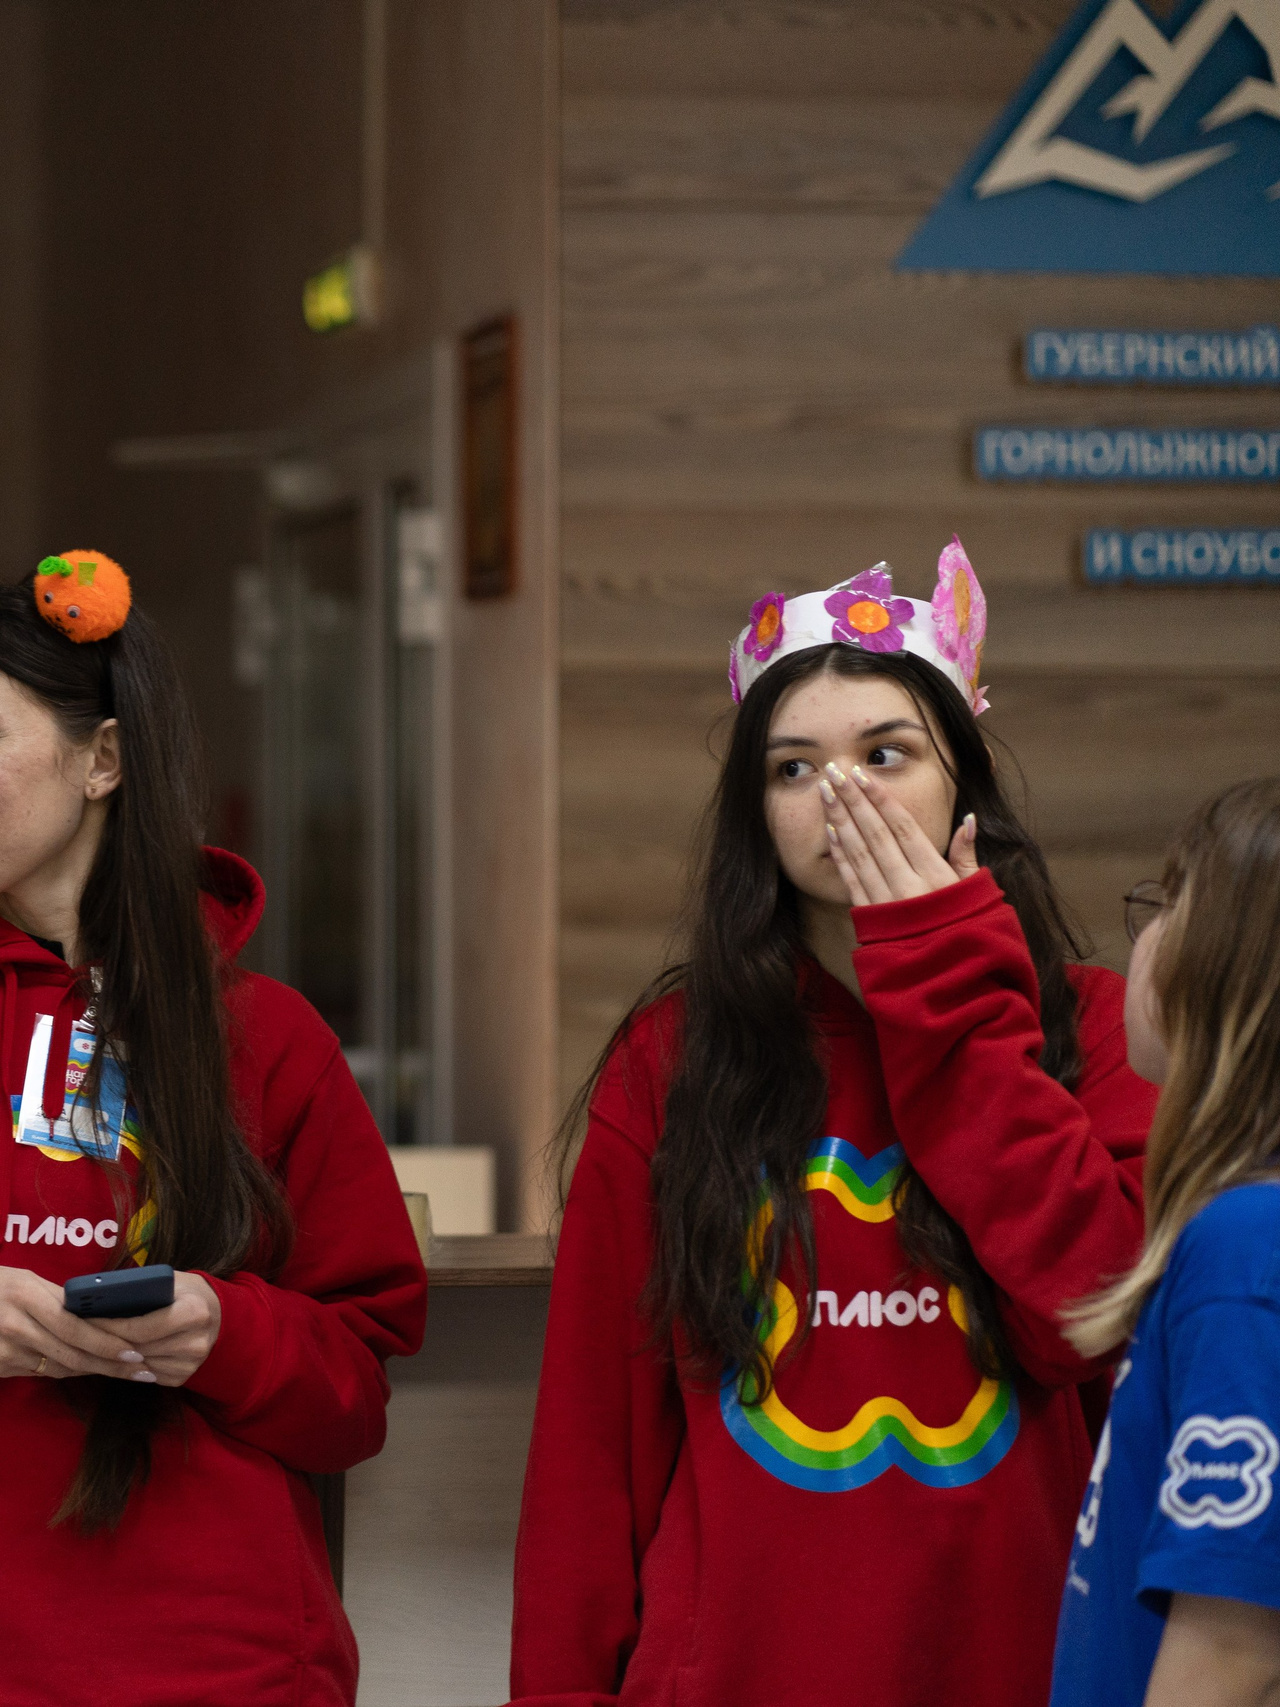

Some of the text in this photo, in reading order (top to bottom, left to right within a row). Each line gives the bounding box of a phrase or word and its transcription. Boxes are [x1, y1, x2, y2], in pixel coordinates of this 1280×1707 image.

[1033, 325, 1280, 377] ГУБЕРНСКИЙ
[1091, 531, 1122, 574] И
[4, 1214, 119, 1248] ПЛЮС
[807, 1286, 941, 1328] ПЛЮС
